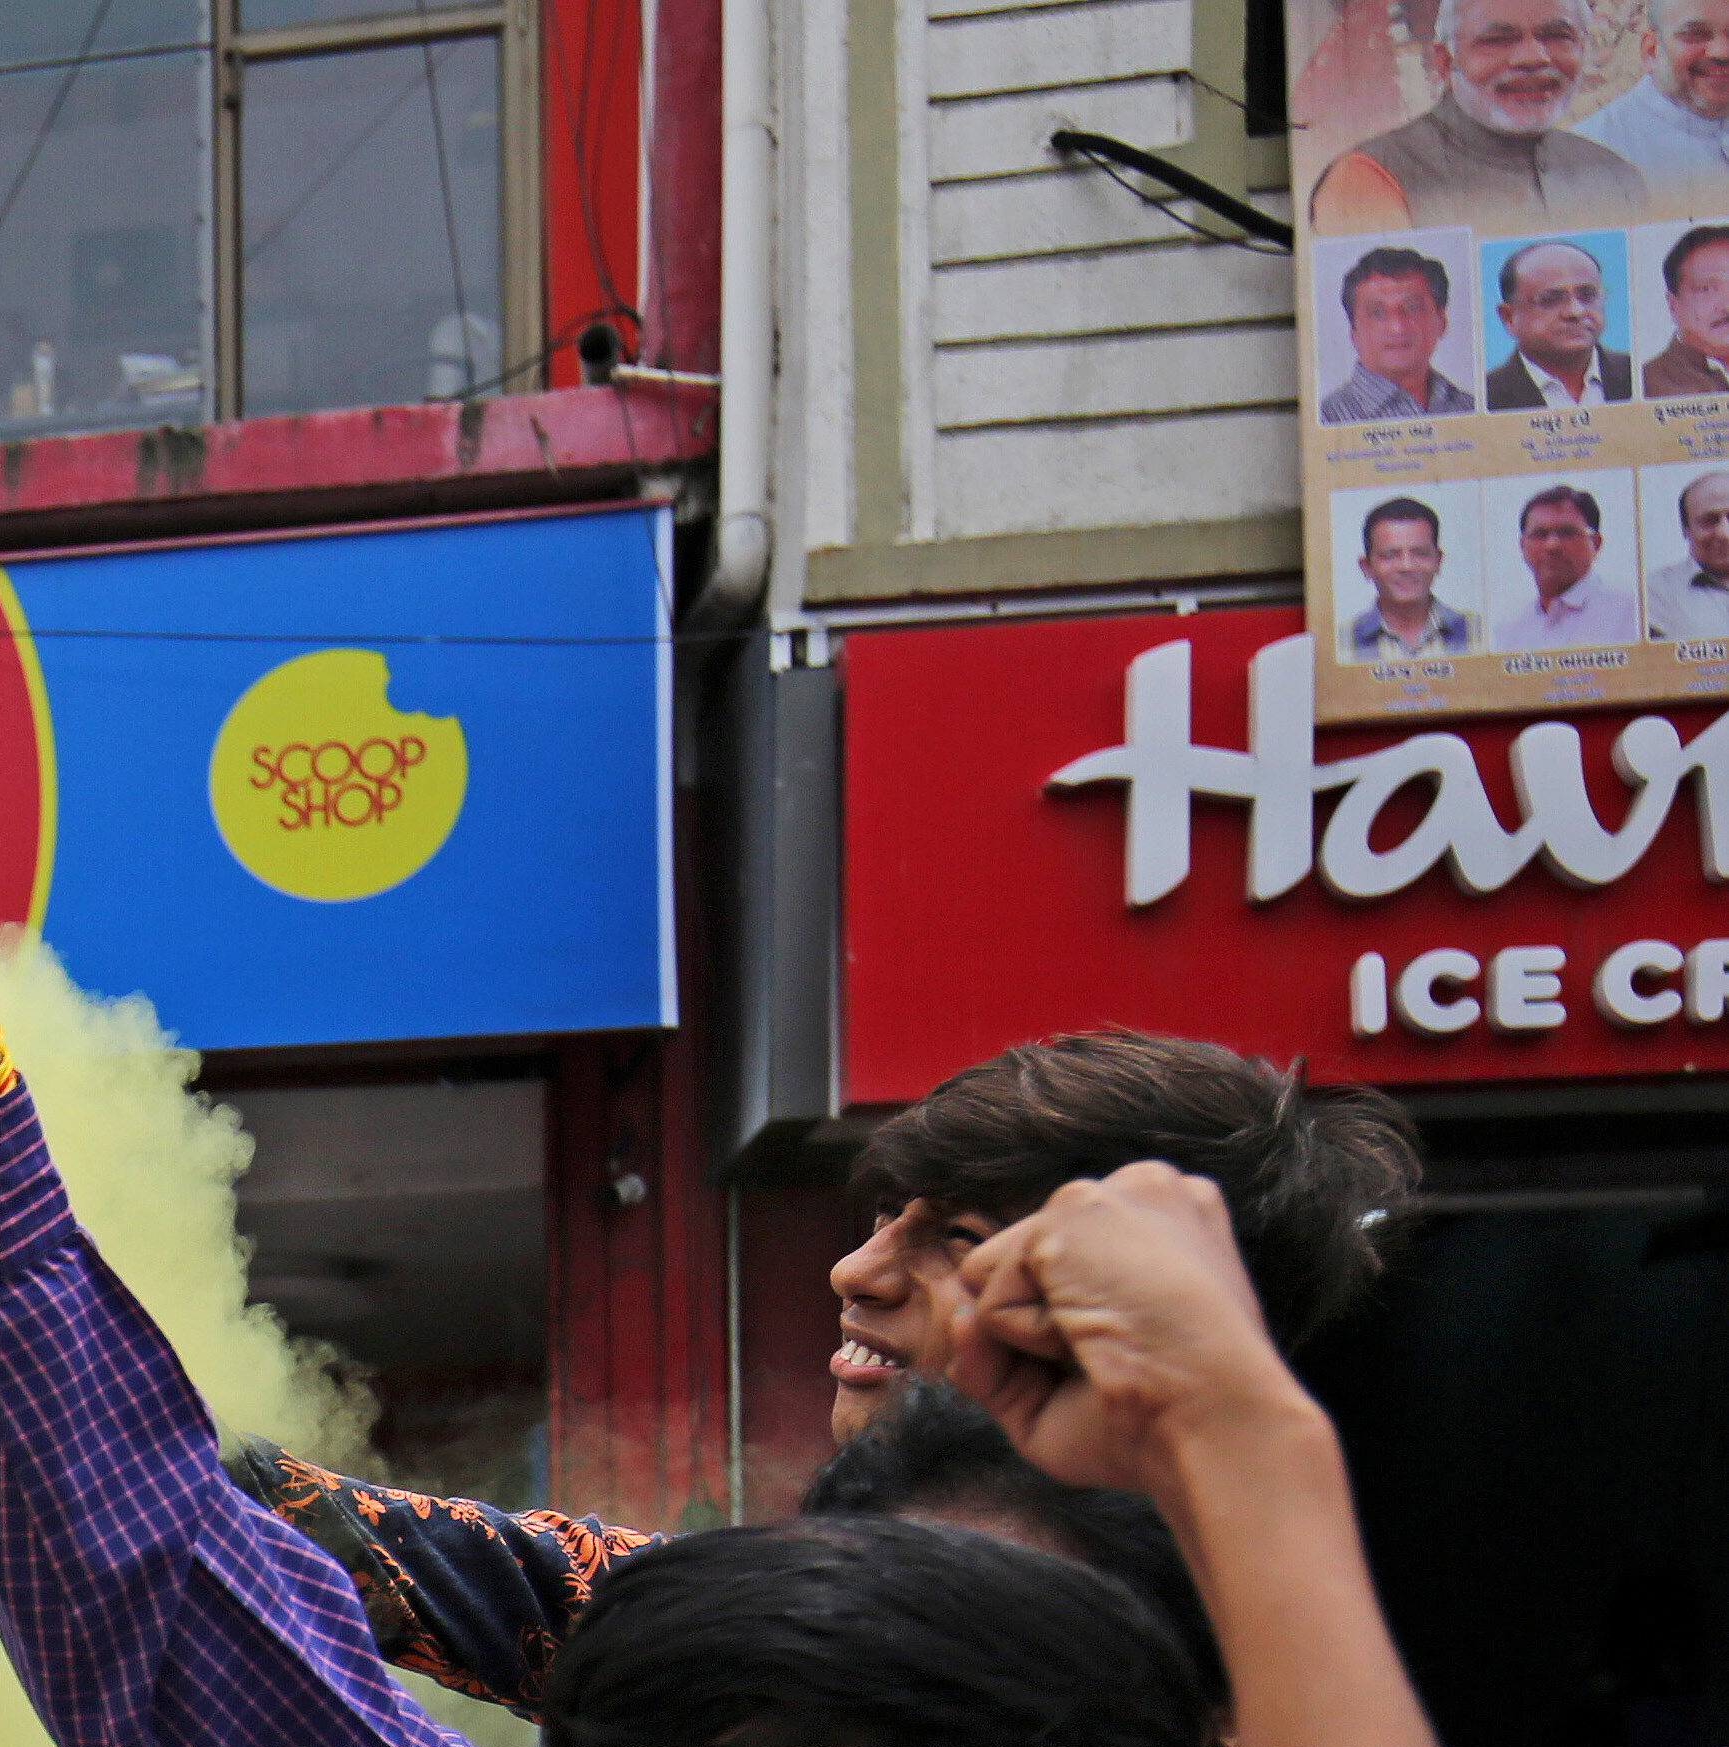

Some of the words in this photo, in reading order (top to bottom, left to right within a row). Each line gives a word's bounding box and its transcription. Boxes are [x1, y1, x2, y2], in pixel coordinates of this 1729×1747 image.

[248, 735, 427, 790] SCOOP
[278, 780, 403, 831] SHOP
[1349, 943, 1568, 1041] ICE
